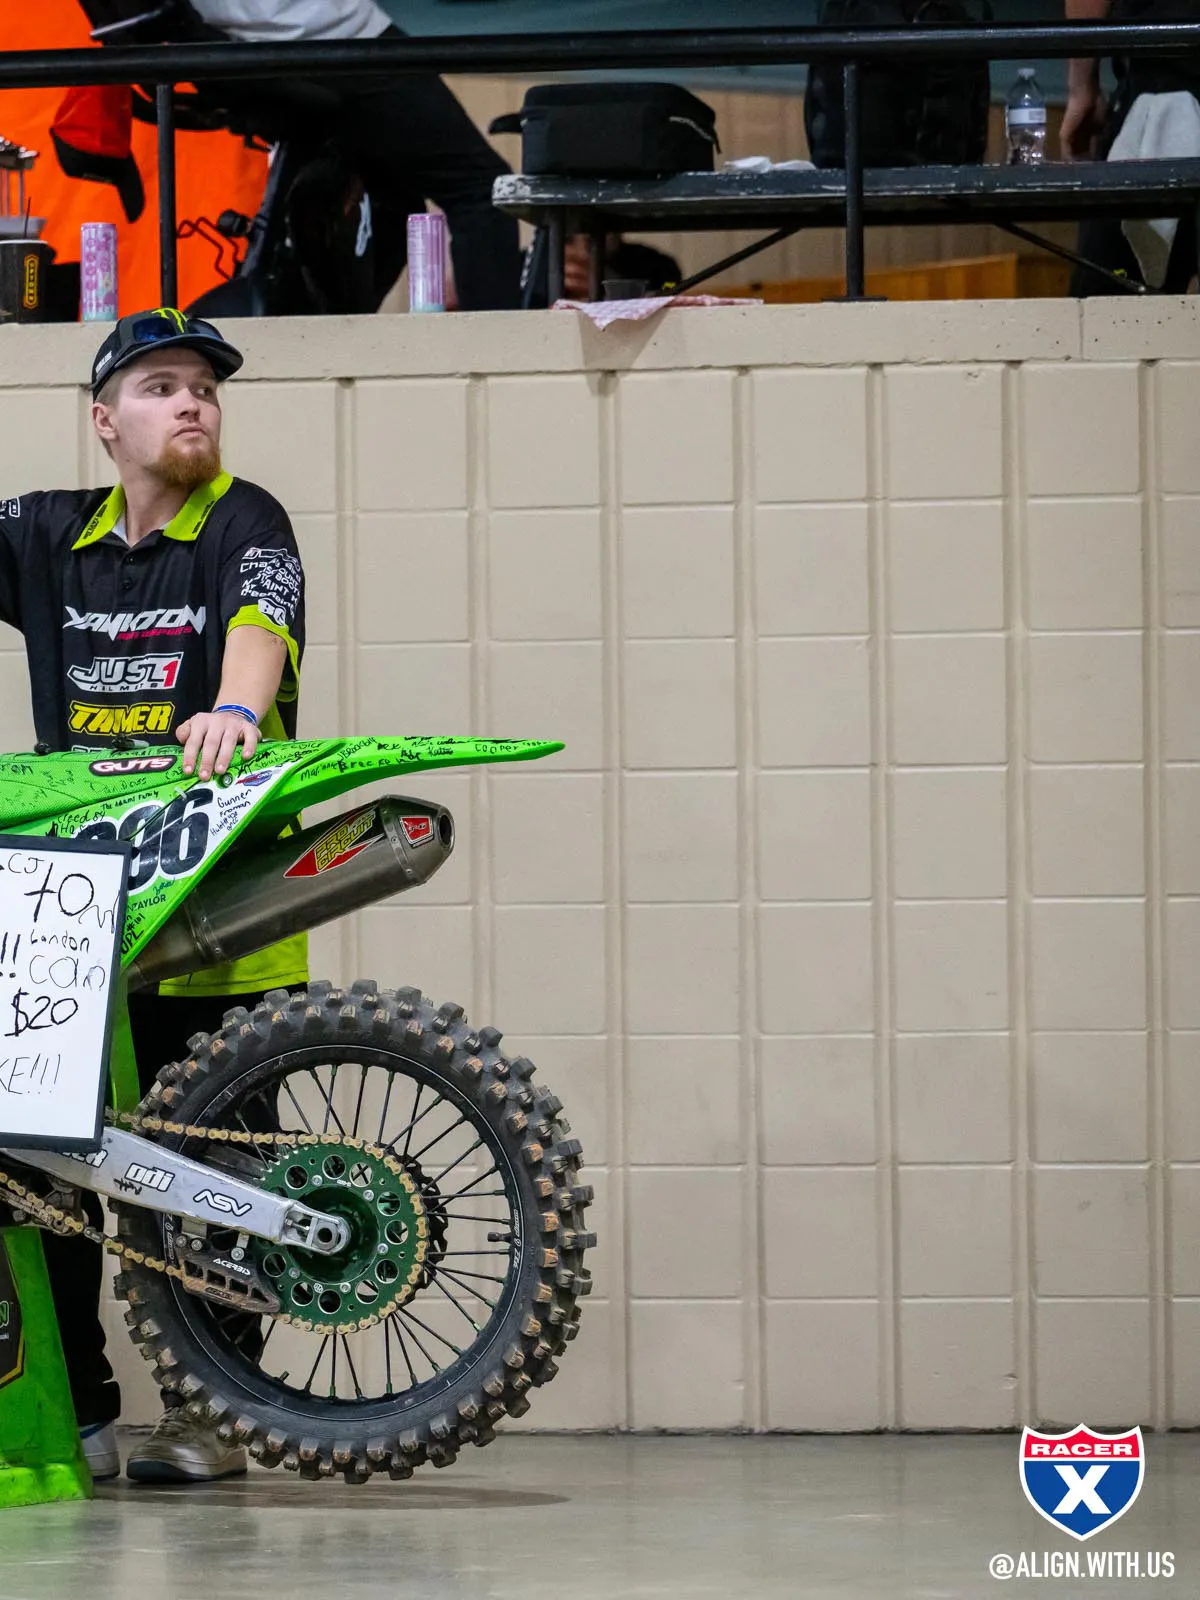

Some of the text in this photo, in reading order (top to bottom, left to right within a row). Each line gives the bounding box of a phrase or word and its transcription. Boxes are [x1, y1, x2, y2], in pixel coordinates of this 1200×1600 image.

[70, 656, 179, 688] JUST1
[70, 703, 175, 734] TAMER
[92, 756, 174, 772] GUTS
[24, 862, 97, 923] to
[5, 988, 80, 1038] $20
[125, 1162, 175, 1193] odi
[194, 1189, 252, 1217] ASV
[213, 1257, 251, 1276] ACERBIS
